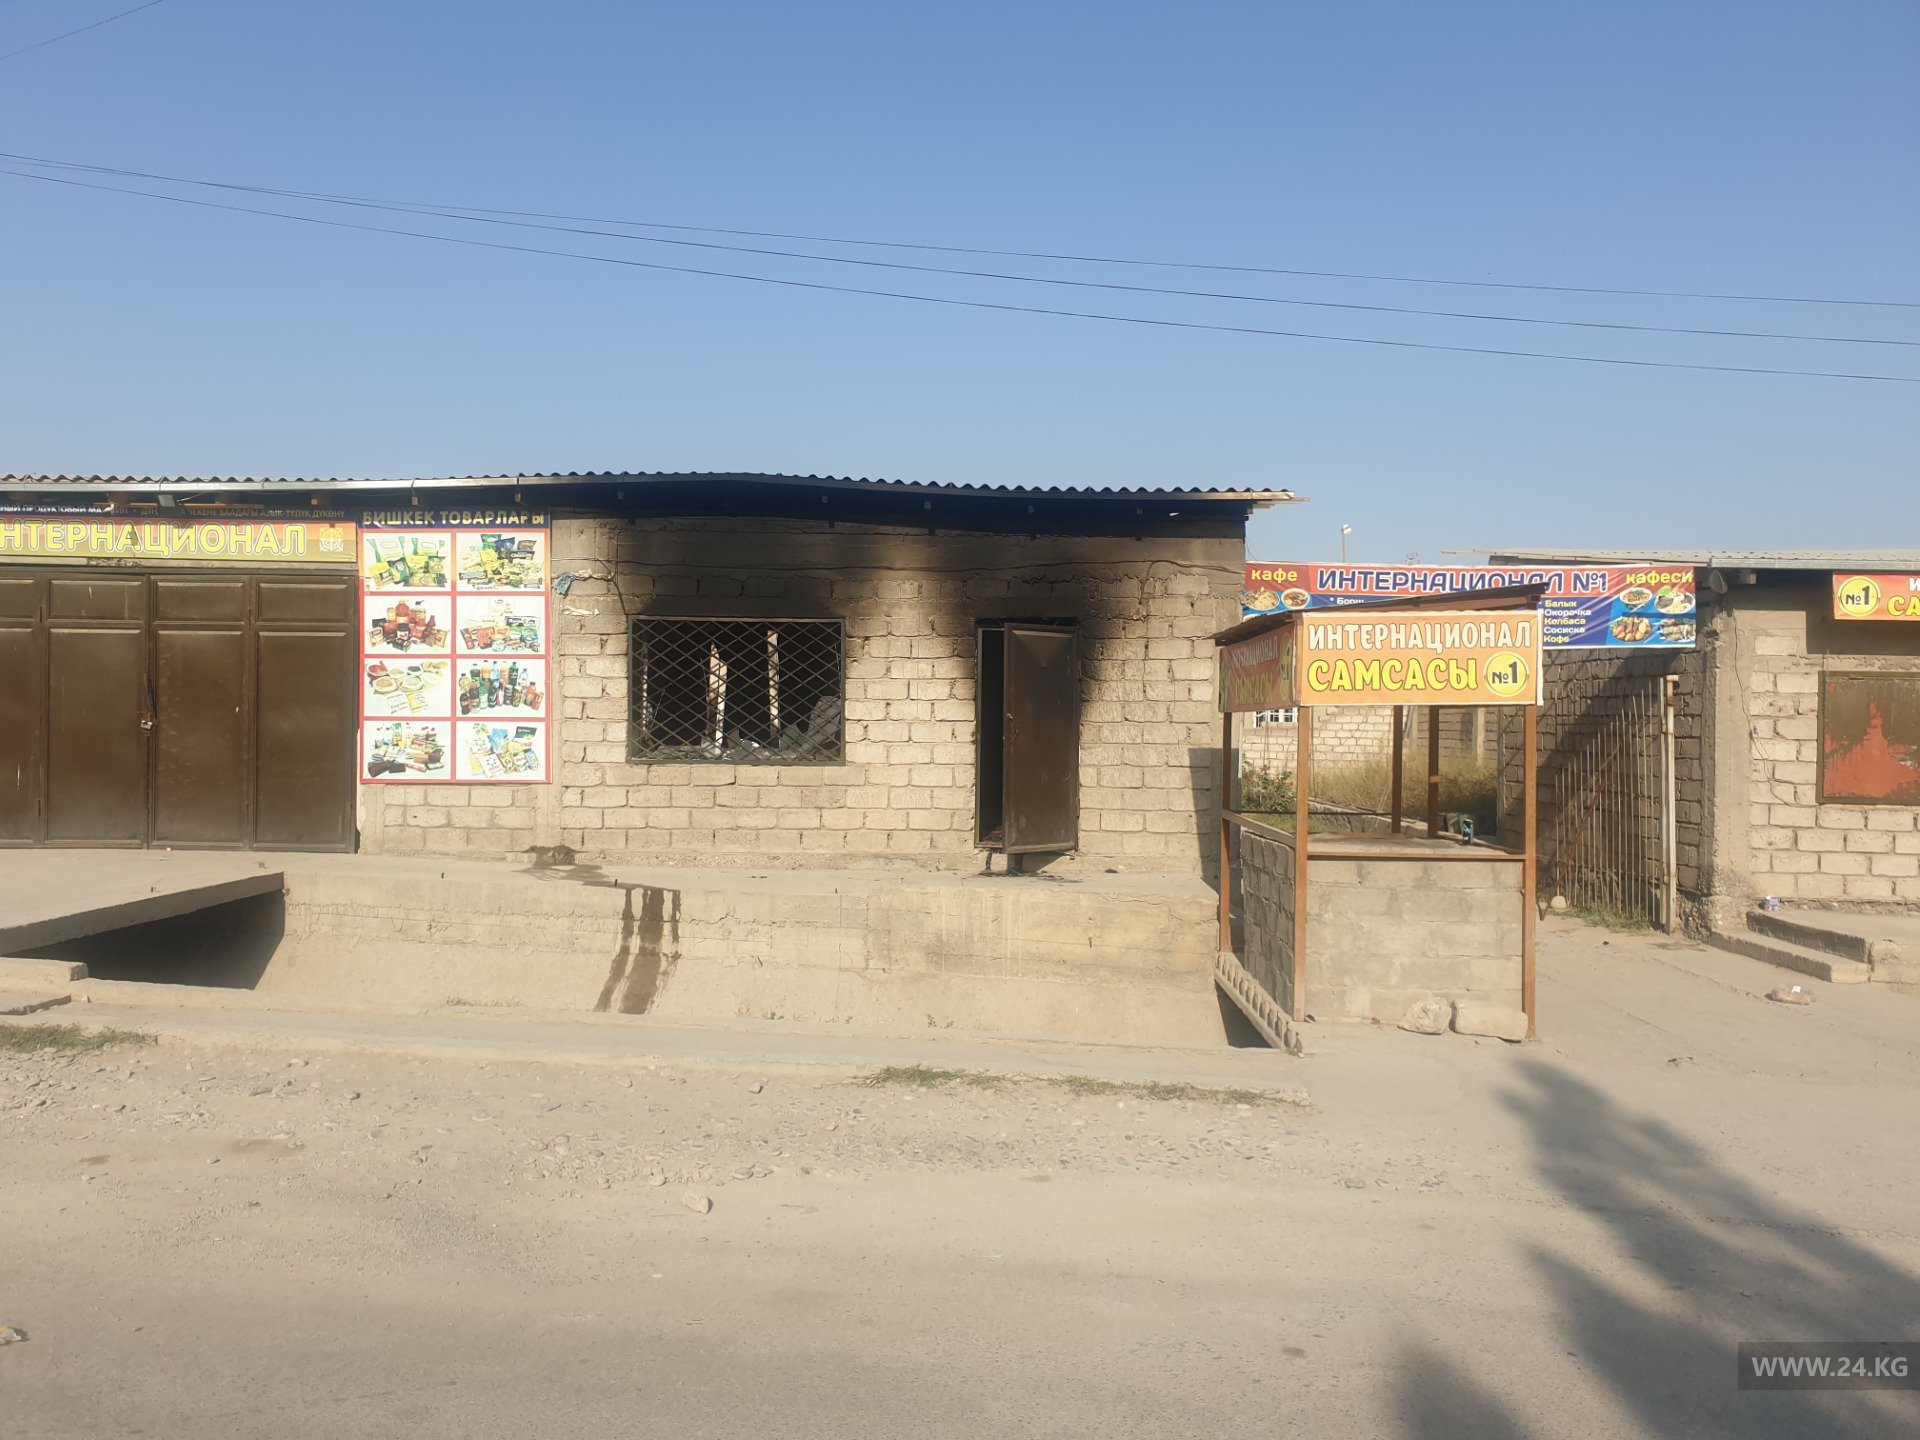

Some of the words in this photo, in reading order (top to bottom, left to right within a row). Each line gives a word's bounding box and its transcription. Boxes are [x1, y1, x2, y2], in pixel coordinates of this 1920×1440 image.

[23, 504, 86, 513] ПРОДУКТОВЫЙ
[88, 504, 128, 514] МАИН
[220, 508, 258, 518] БААДАГЫ
[362, 510, 435, 525] БИШКЕК
[440, 510, 544, 526] ТОВАРЛАРЫ
[1251, 568, 1298, 583] кафе
[1317, 568, 1564, 594] ИНТЕРНАЦИОНАЛ
[1572, 571, 1609, 594] №1
[1626, 571, 1694, 585] кафеси
[1845, 585, 1870, 605] №1
[1545, 600, 1577, 608] Балык
[1545, 617, 1586, 625] Колбаса
[1308, 621, 1532, 653] ИНТЕРНАЦИОНАЛ
[1544, 626, 1586, 634] Сосиска
[1544, 635, 1570, 643] Кофе
[1307, 657, 1478, 692] САМСАСЫ
[1491, 661, 1518, 684] №1
